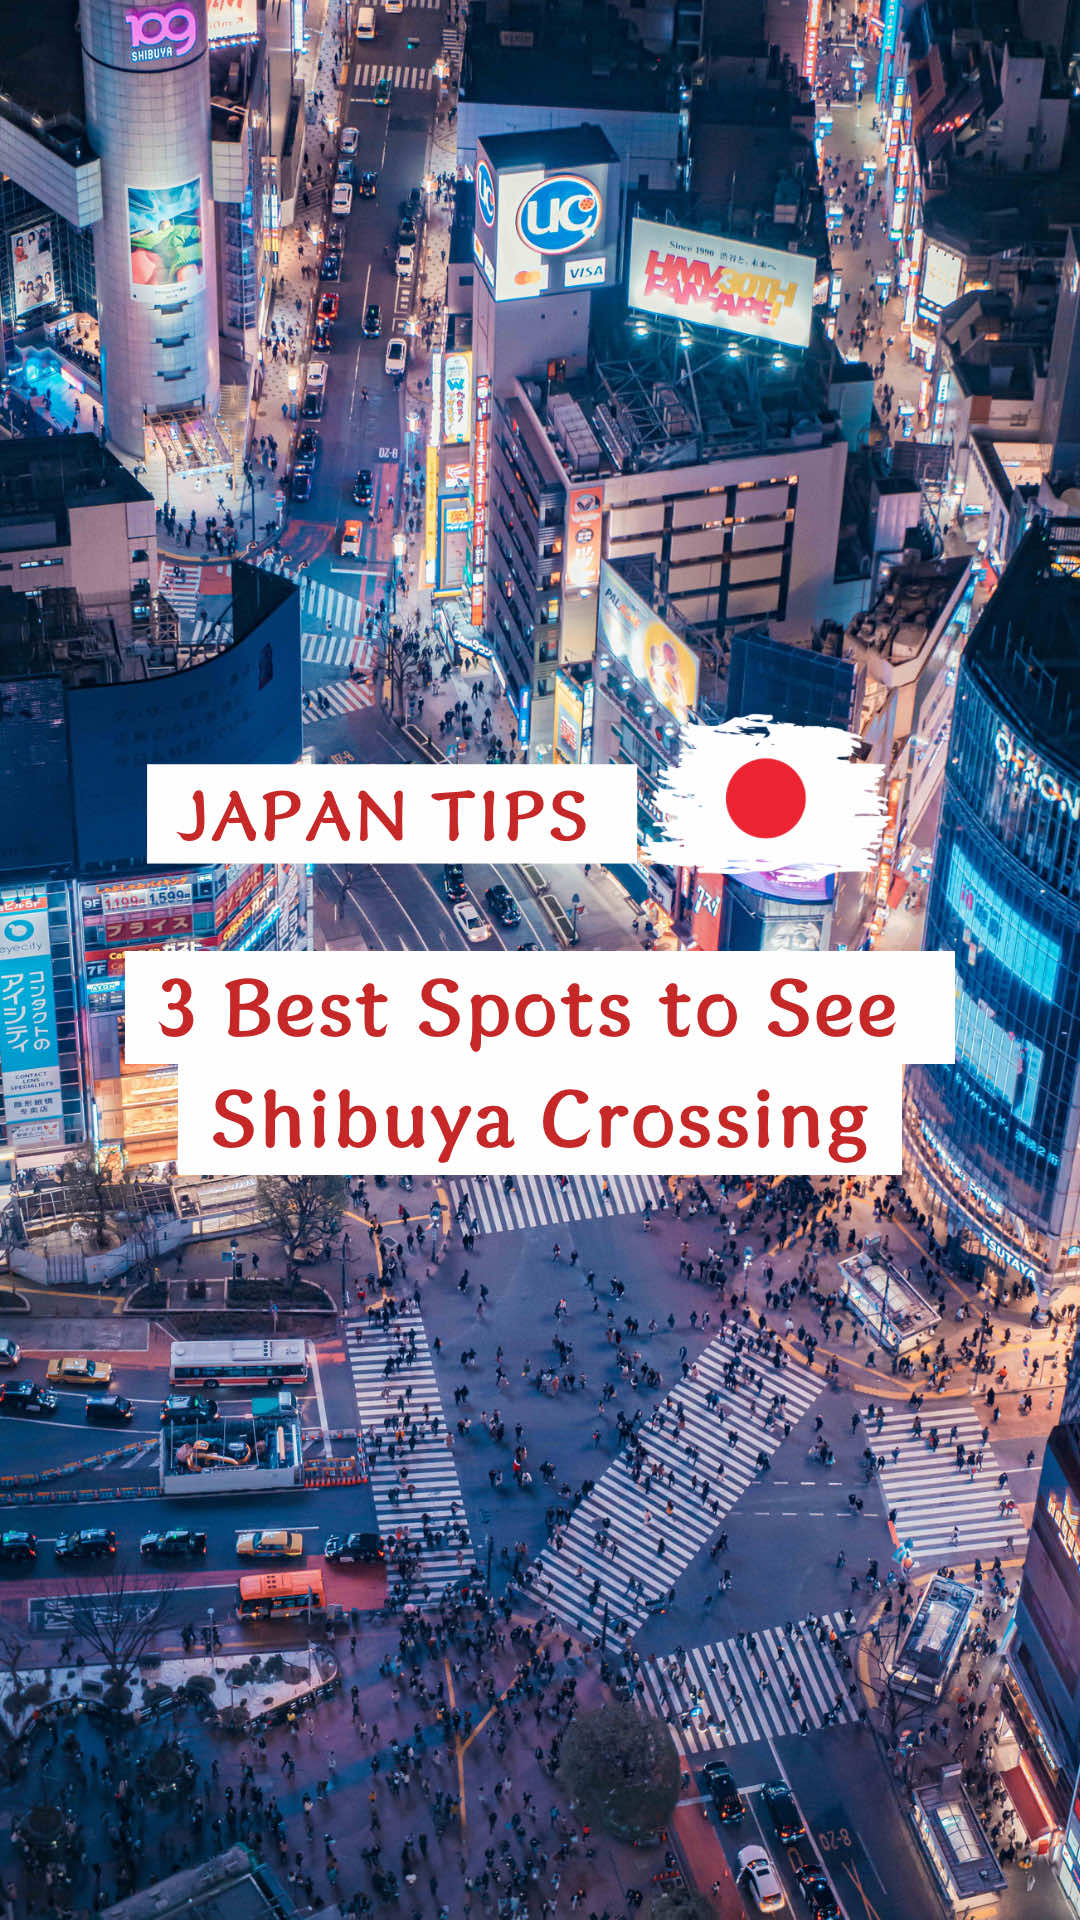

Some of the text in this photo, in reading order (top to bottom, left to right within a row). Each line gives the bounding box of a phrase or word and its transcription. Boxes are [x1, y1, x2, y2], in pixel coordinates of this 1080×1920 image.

[125, 8, 196, 56] 109
[131, 46, 173, 62] SHIBUYA
[527, 194, 595, 235] UC
[569, 265, 604, 280] VISA
[84, 899, 101, 909] 9F
[88, 964, 106, 976] 7F
[1, 973, 29, 1053] アイシティ
[29, 970, 51, 1052] コンタクトの
[16, 1071, 47, 1079] CONTACT
[981, 1232, 1036, 1281] TSUTAYA
